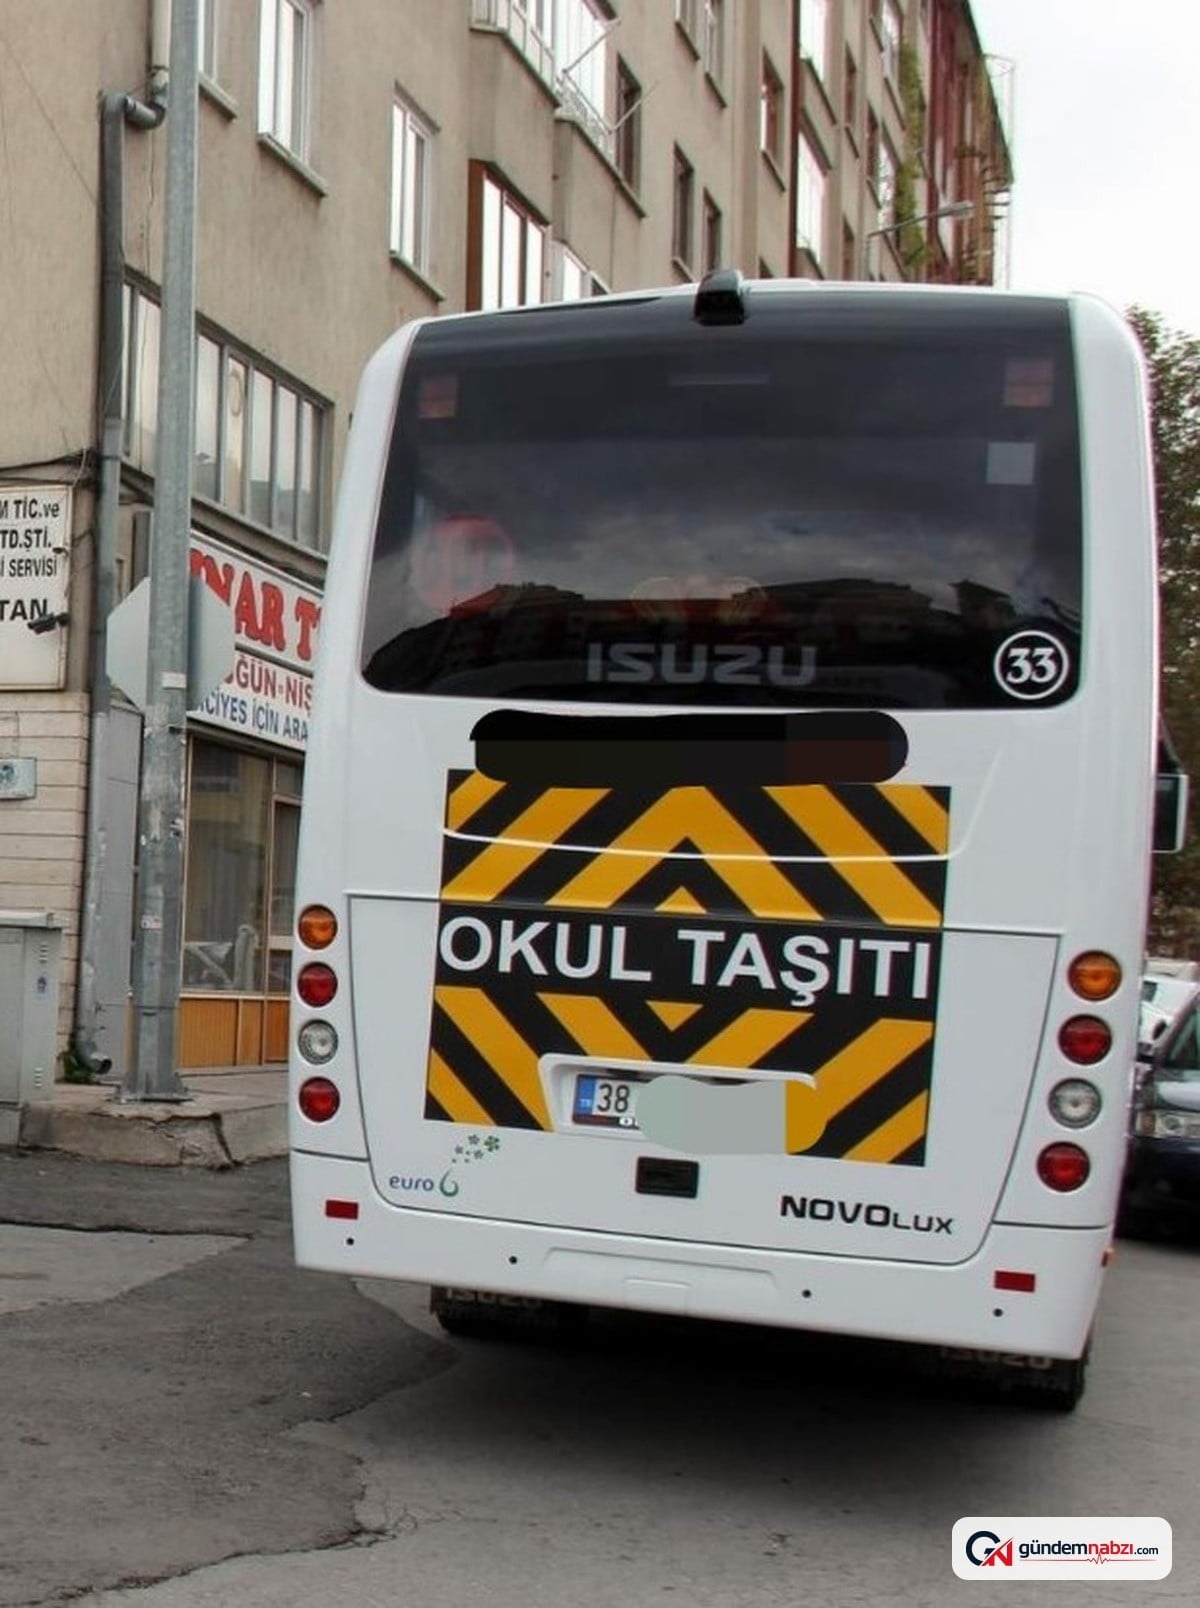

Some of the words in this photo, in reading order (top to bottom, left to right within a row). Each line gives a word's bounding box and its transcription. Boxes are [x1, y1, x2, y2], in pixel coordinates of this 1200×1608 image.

[9, 554, 58, 577] SERVİSİ
[587, 642, 817, 686] ISUZU
[1006, 647, 1057, 684] 33
[439, 917, 652, 982] OKUL
[677, 929, 931, 1006] TAŞITI
[597, 1083, 630, 1113] 38
[389, 1175, 435, 1192] euro
[780, 1195, 953, 1235] NOVOLUX
